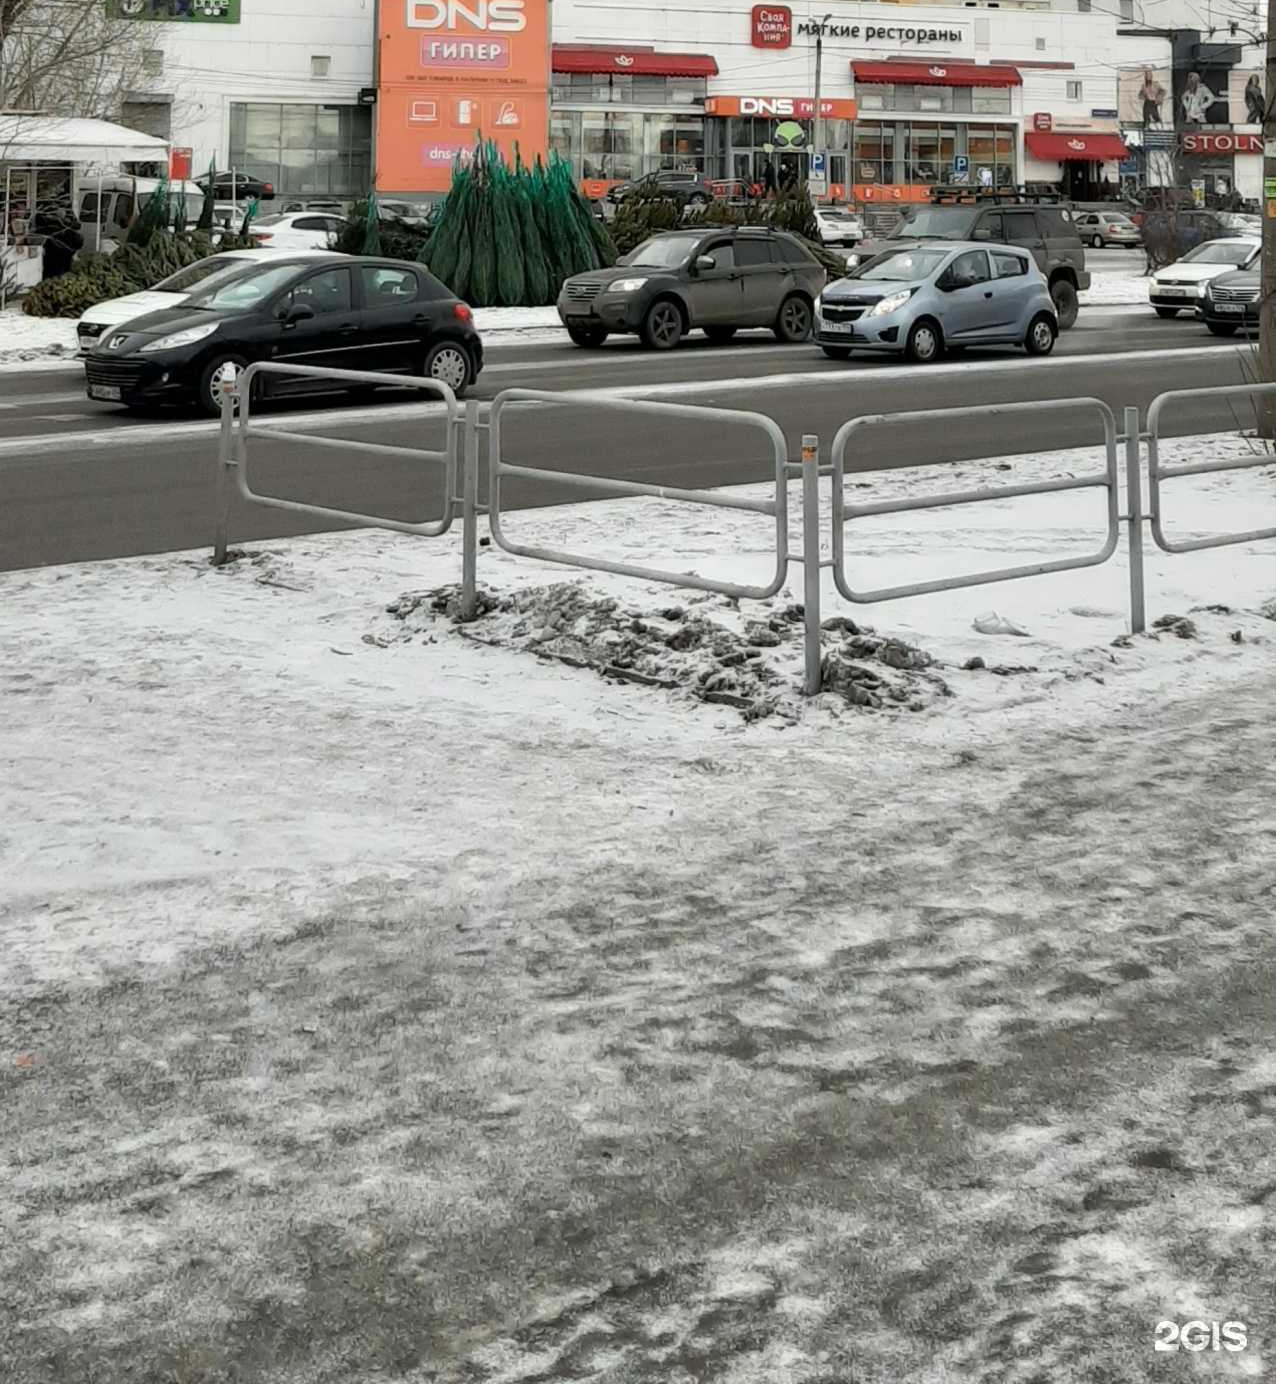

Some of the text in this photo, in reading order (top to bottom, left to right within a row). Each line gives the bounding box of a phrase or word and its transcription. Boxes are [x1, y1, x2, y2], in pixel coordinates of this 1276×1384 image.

[798, 23, 962, 42] мягкие рестораны
[431, 41, 502, 60] ГИПЕР
[740, 98, 794, 115] DNS
[800, 102, 833, 112] ГИЕР
